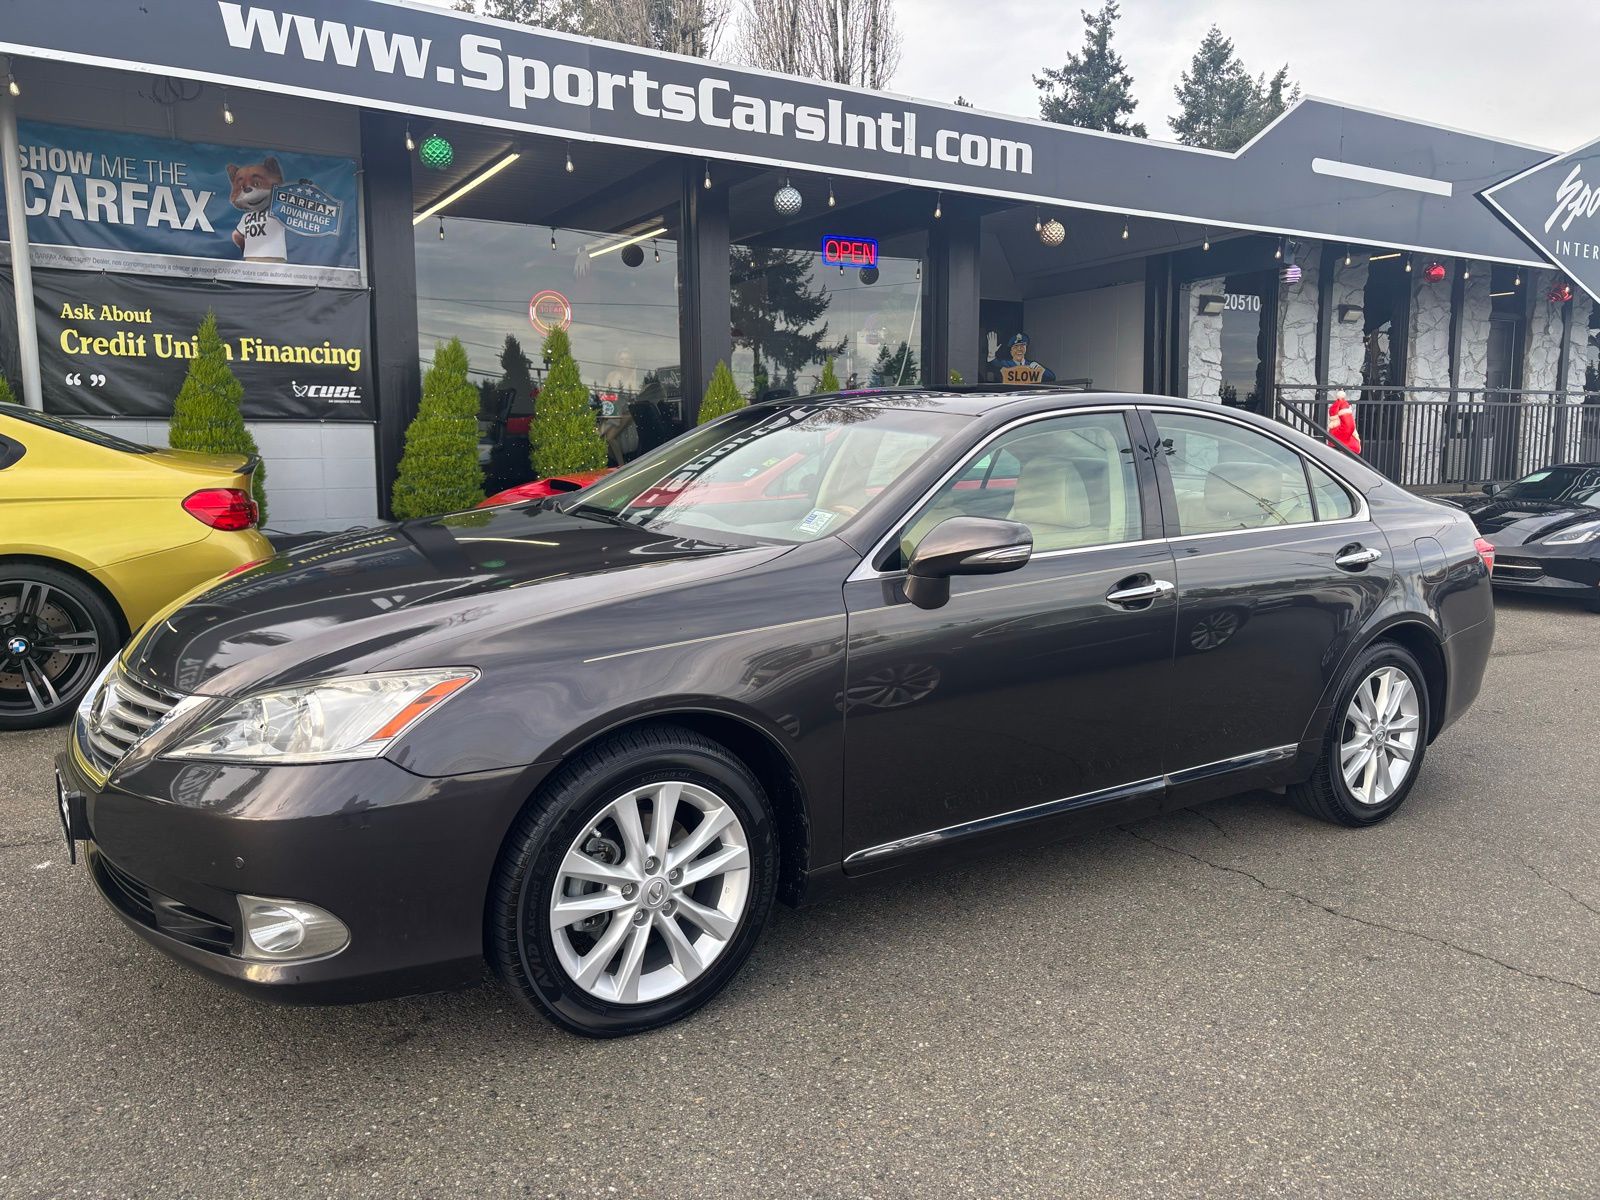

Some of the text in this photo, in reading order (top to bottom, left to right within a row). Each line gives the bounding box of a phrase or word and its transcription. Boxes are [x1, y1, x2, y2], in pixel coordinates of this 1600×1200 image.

[217, 0, 1033, 174] www.SportsCarsIntl.com
[18, 144, 187, 186] SHOW ME THE
[22, 170, 215, 233] CARFAX
[278, 192, 336, 217] CARFAX
[244, 211, 267, 225] CAR
[280, 205, 330, 226] ADVANTAGE
[286, 216, 320, 232] DEALER
[244, 223, 267, 239] FOX
[825, 240, 875, 265] OPEN
[60, 302, 152, 323] Ask About
[1223, 293, 1261, 311] 20510
[60, 328, 361, 371] Credit Unin Financing
[1007, 371, 1040, 383] SLOW
